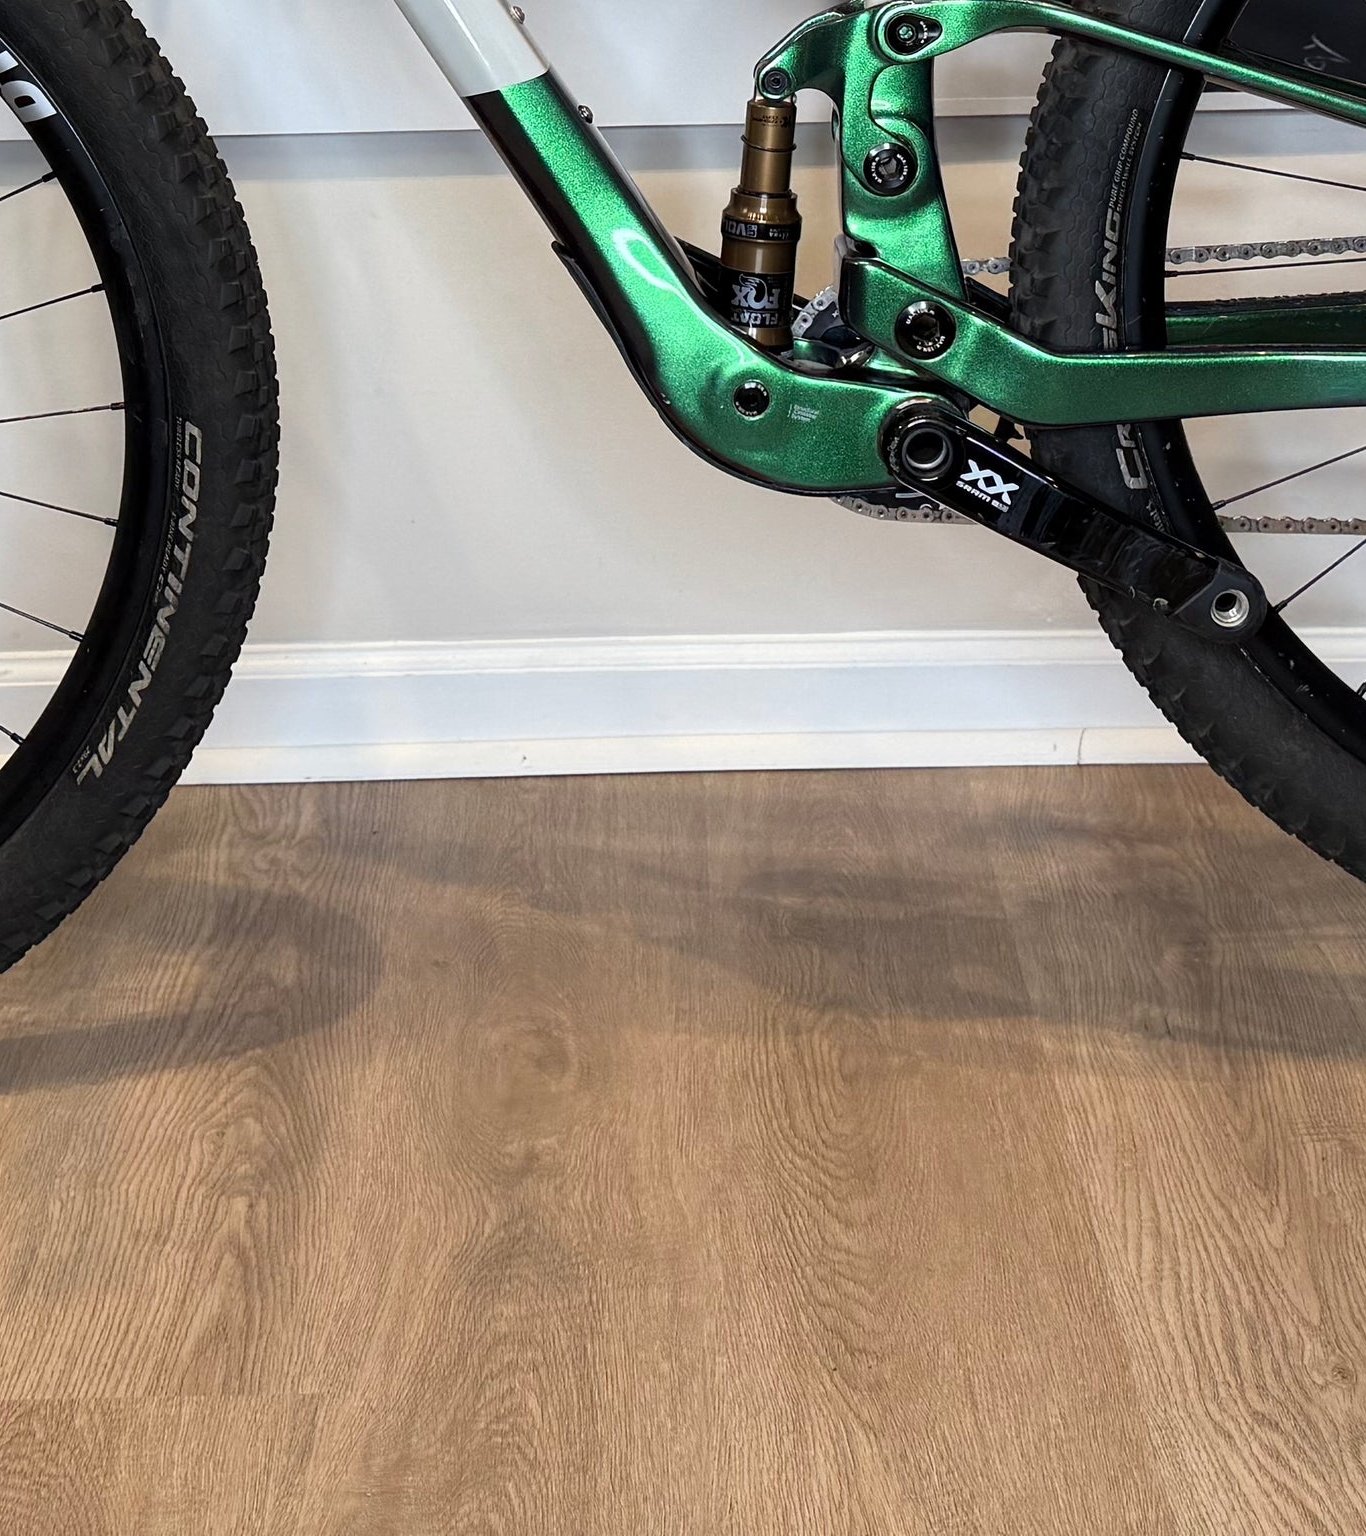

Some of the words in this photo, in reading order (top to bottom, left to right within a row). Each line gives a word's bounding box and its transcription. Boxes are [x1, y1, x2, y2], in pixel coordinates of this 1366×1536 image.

[956, 480, 991, 503] SRAM
[960, 458, 1019, 505] XX
[77, 421, 203, 786] CONTINENTAL
